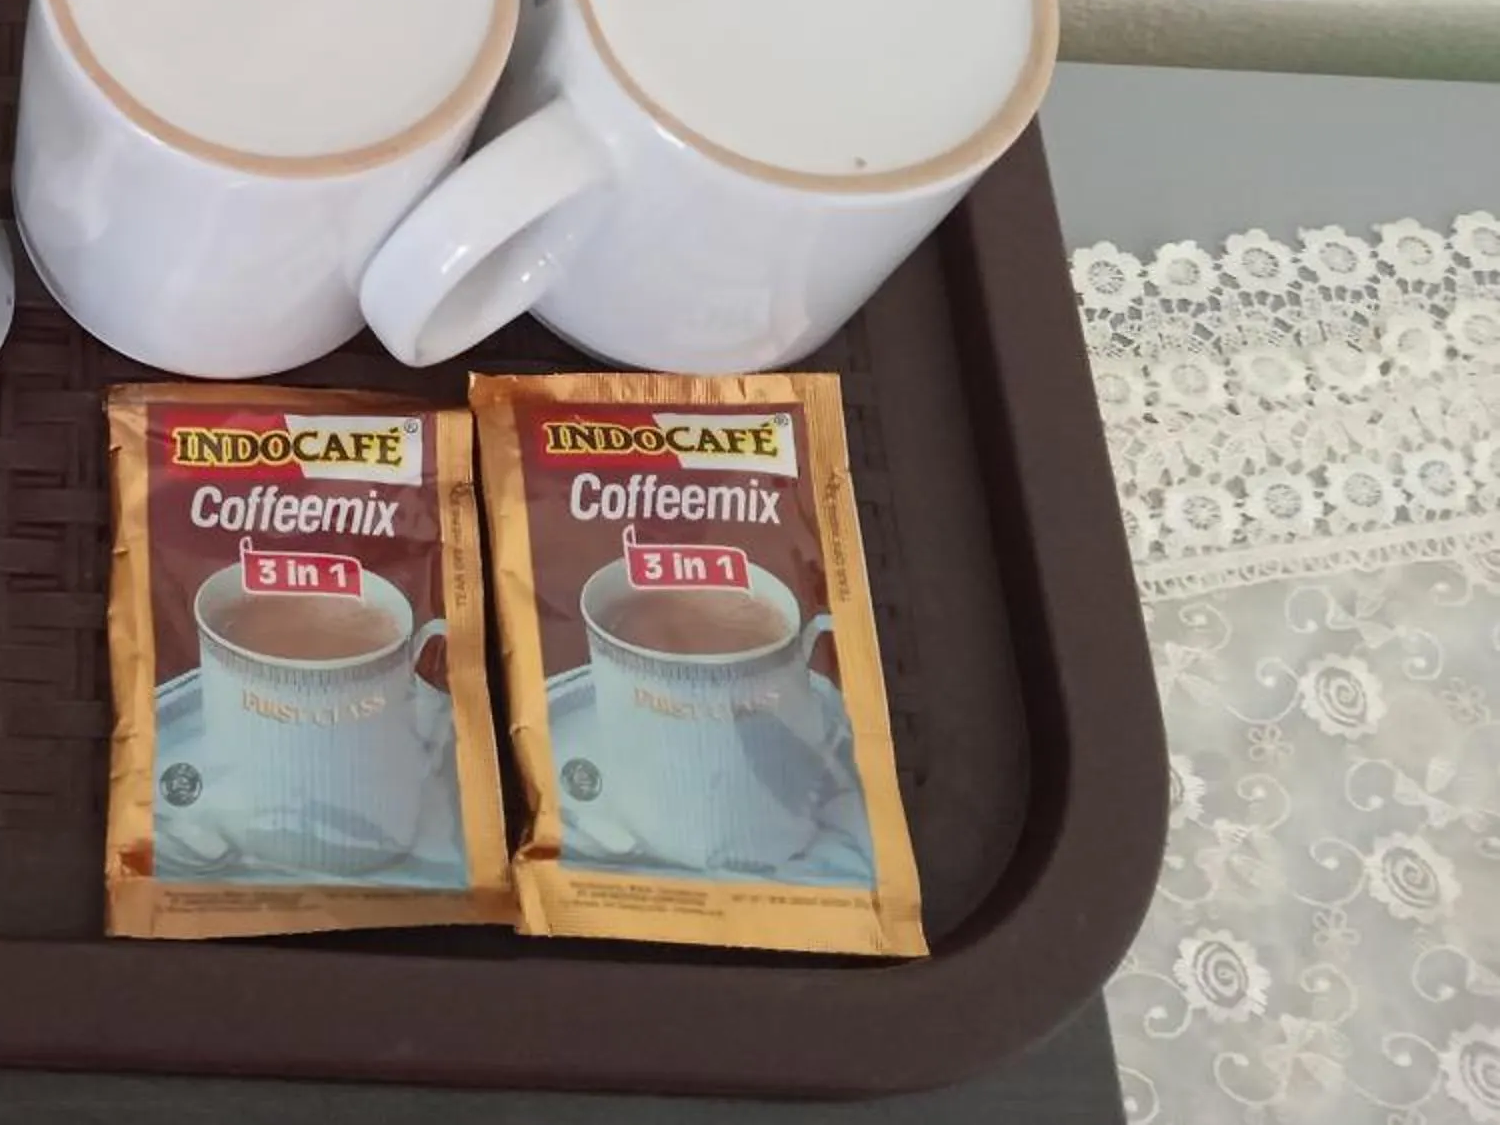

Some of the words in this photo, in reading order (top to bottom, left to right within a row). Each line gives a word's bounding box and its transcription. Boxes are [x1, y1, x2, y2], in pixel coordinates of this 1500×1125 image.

[174, 425, 404, 468] INDOCAFÉ
[543, 419, 779, 458] INDOCAFÉ
[191, 485, 401, 538] Coffeemix
[570, 472, 782, 526] Coffeemix
[258, 558, 278, 586] 3
[287, 559, 319, 587] in
[329, 562, 348, 588] 1
[643, 553, 663, 580] 3
[673, 552, 706, 581] in
[716, 554, 735, 581] 1
